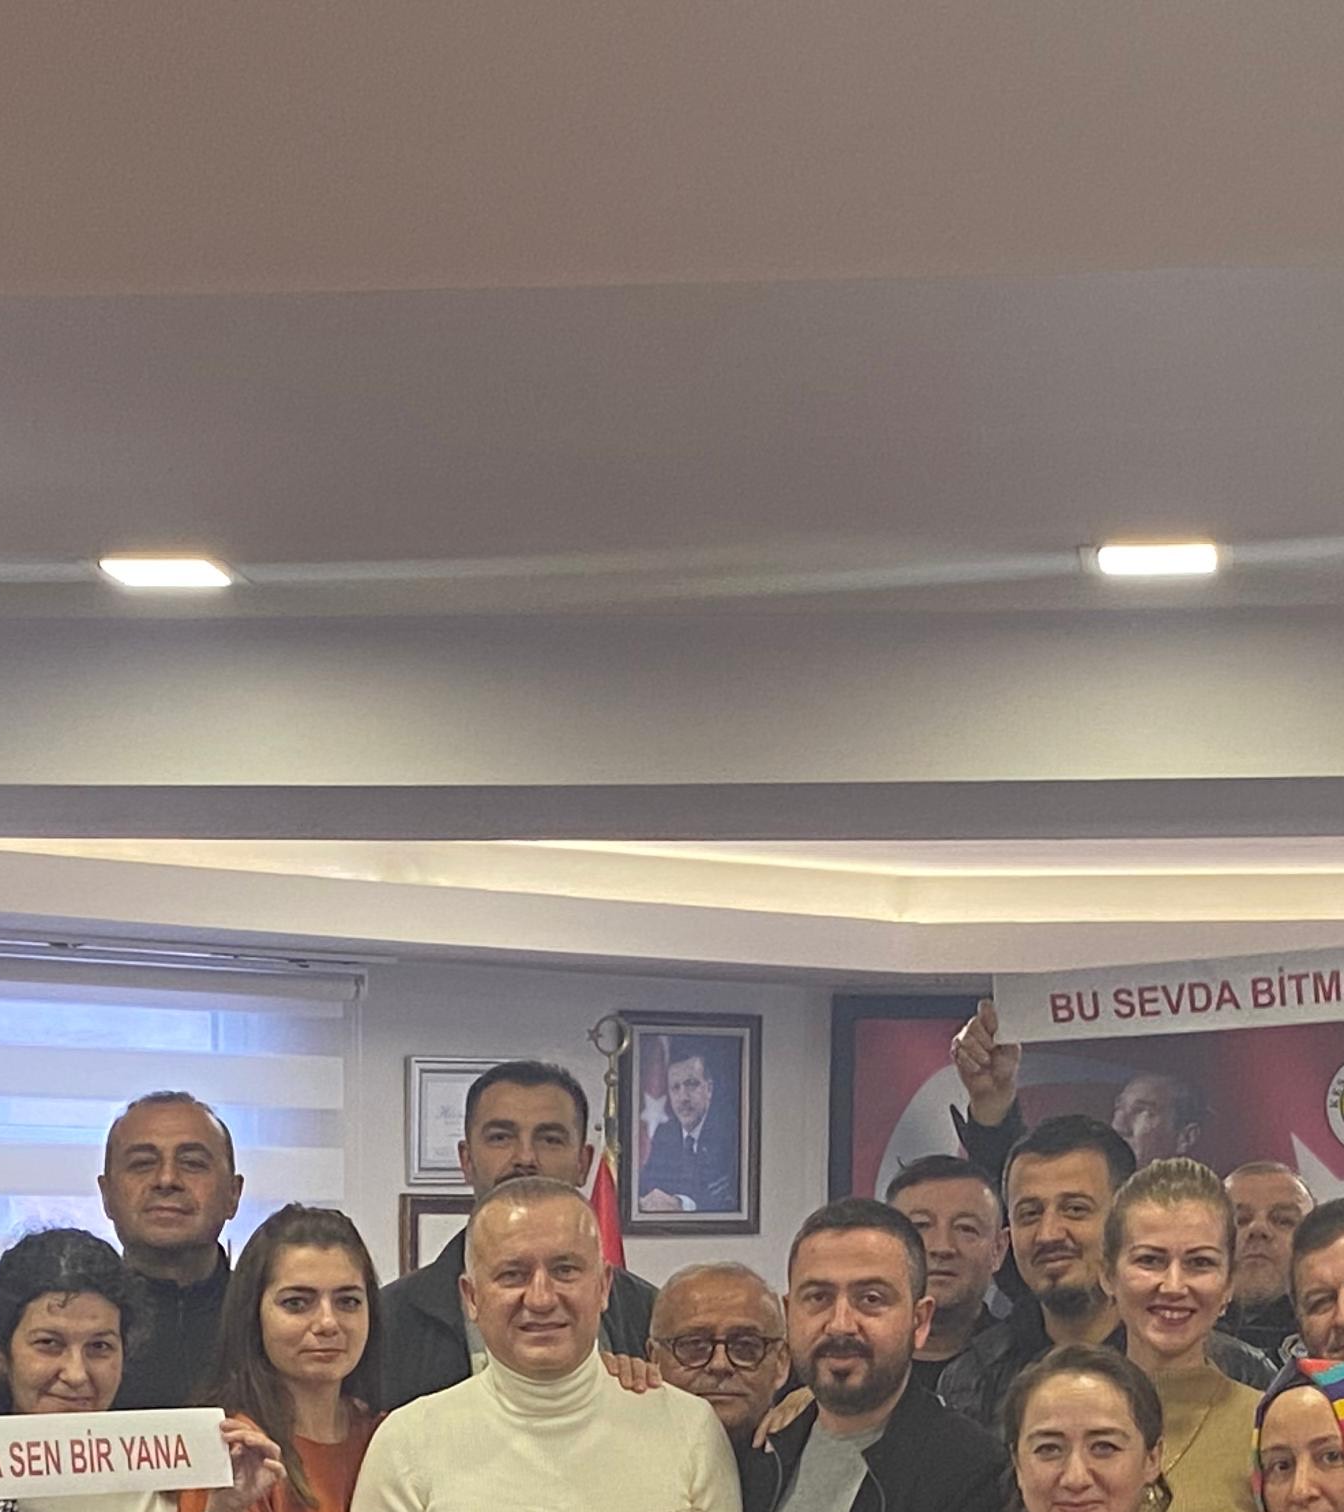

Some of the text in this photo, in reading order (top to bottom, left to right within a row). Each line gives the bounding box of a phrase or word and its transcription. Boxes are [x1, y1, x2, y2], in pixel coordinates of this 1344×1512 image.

[1049, 991, 1100, 1023] BU
[1113, 979, 1241, 1020] SEVDA
[9, 1439, 62, 1477] SEN
[71, 1430, 115, 1474] BİR
[120, 1434, 192, 1471] YANA
